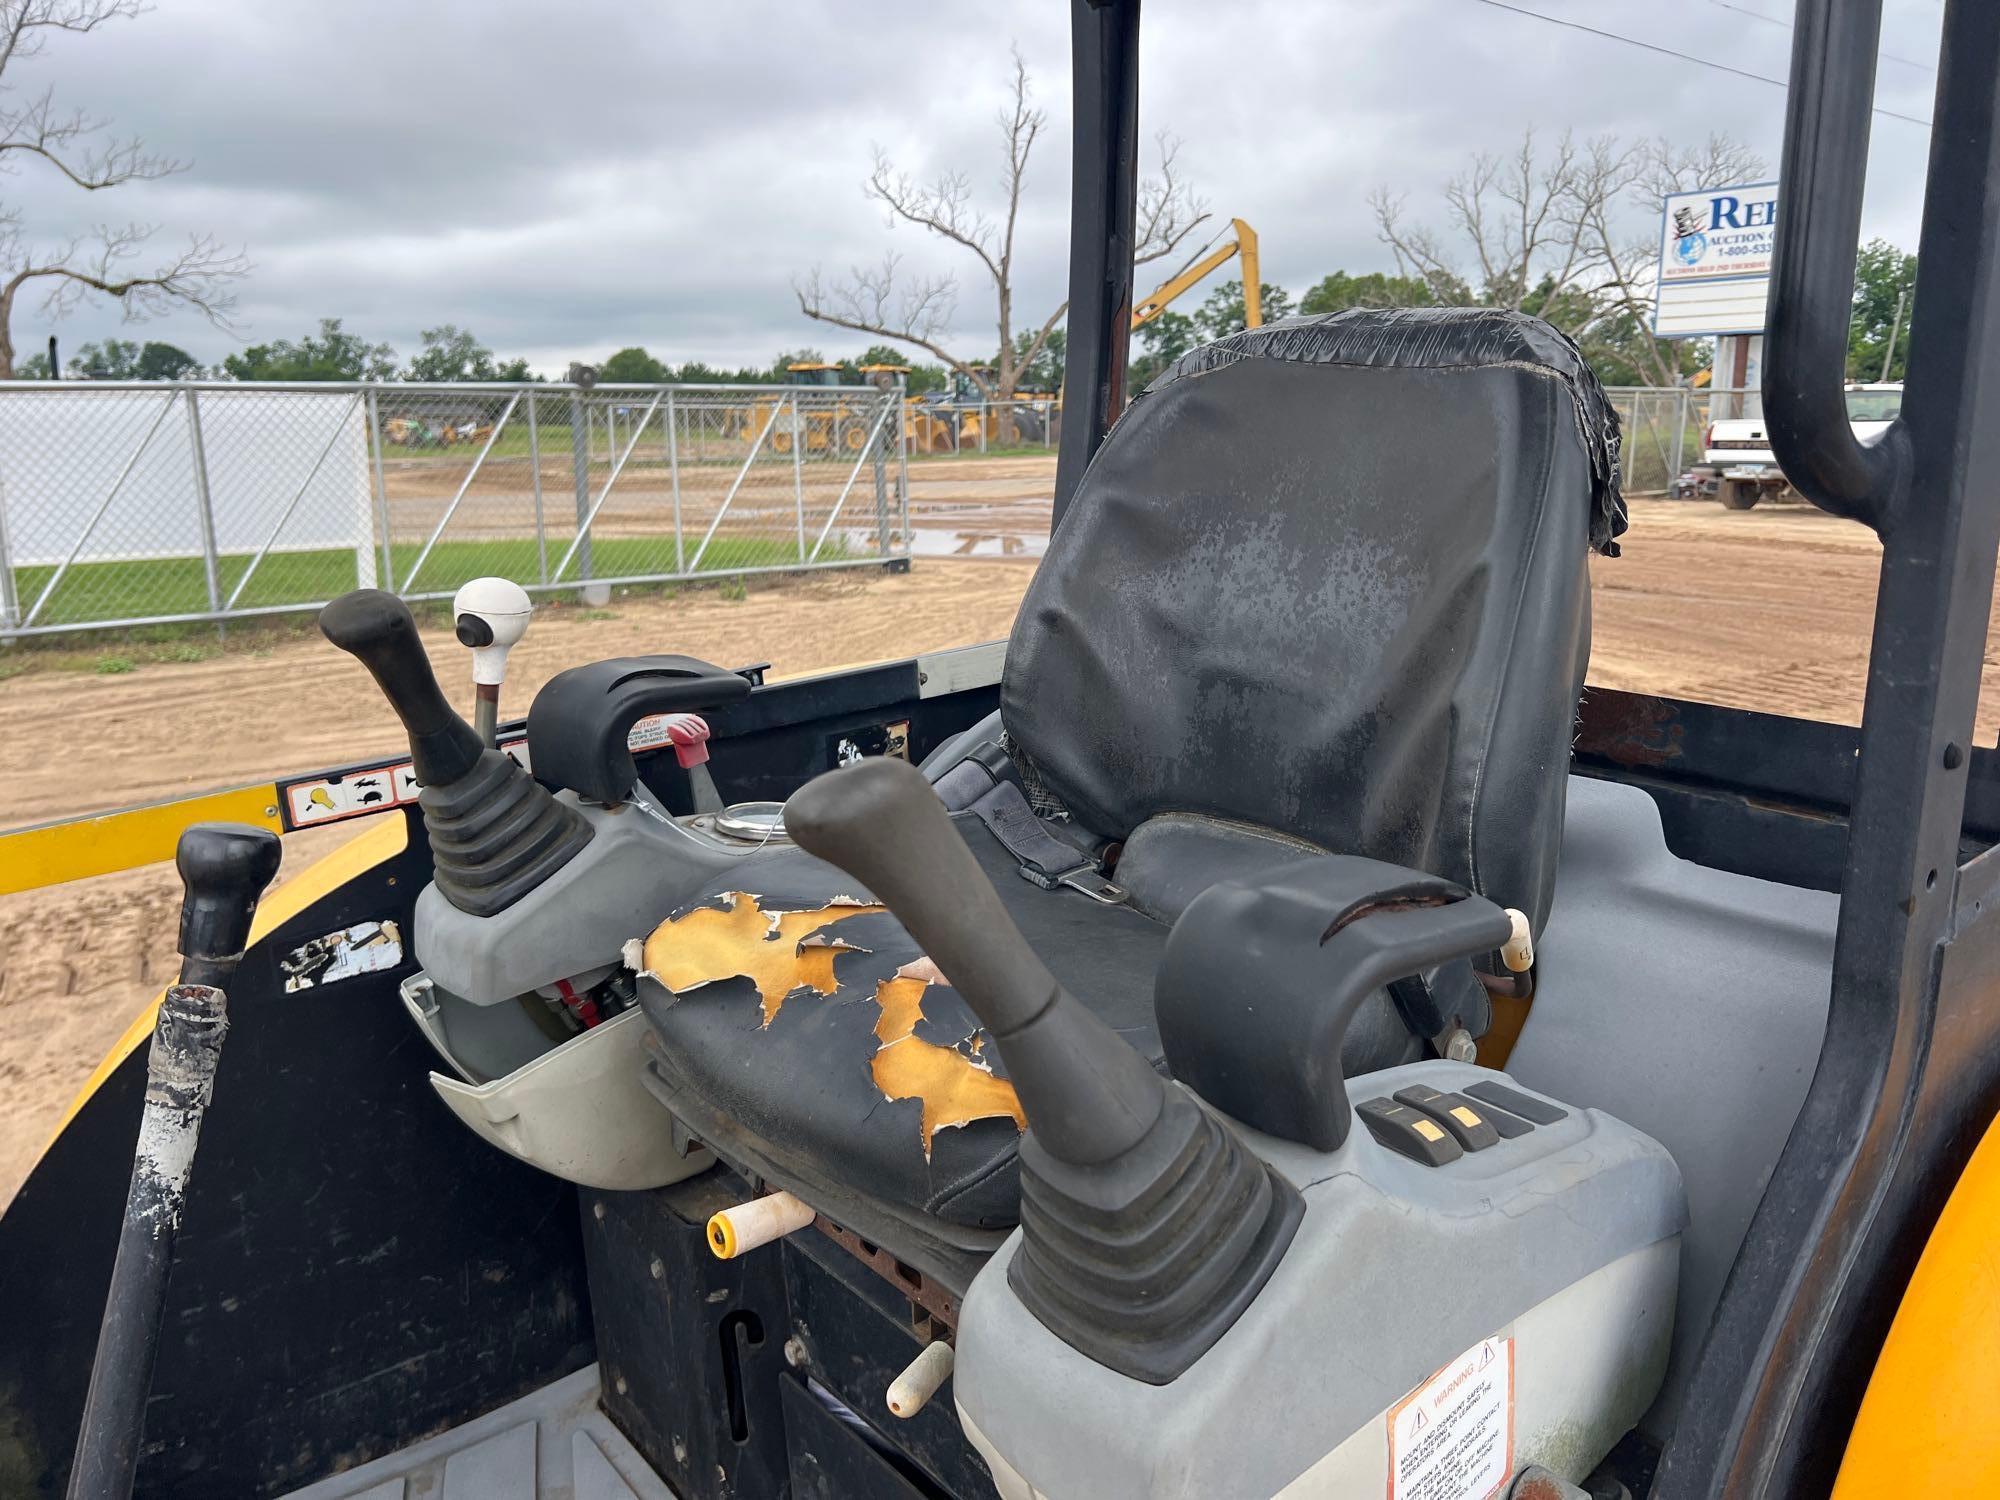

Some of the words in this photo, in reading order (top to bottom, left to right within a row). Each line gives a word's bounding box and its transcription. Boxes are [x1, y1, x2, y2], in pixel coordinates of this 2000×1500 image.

[1711, 233, 1765, 245] AUCTION
[1434, 1361, 1473, 1409] WARNING
[1401, 1442, 1420, 1466] MOUNT
[1423, 1427, 1435, 1445] AND
[1437, 1400, 1464, 1430] DISMOUNT
[1467, 1380, 1485, 1402] SAFELY
[1401, 1454, 1417, 1474] WHEN
[1420, 1425, 1447, 1456] ENTERING
[1449, 1414, 1457, 1428] OR
[1459, 1393, 1480, 1418] LEAVING
[1482, 1381, 1491, 1396] THE
[1406, 1468, 1432, 1497] MAINTAIN
[1435, 1462, 1438, 1471] A
[1440, 1444, 1457, 1465] THREE
[1460, 1426, 1475, 1446] POINT
[1476, 1402, 1499, 1428] CONTACT
[1424, 1469, 1440, 1489] STEPS
[1443, 1455, 1454, 1471] AND
